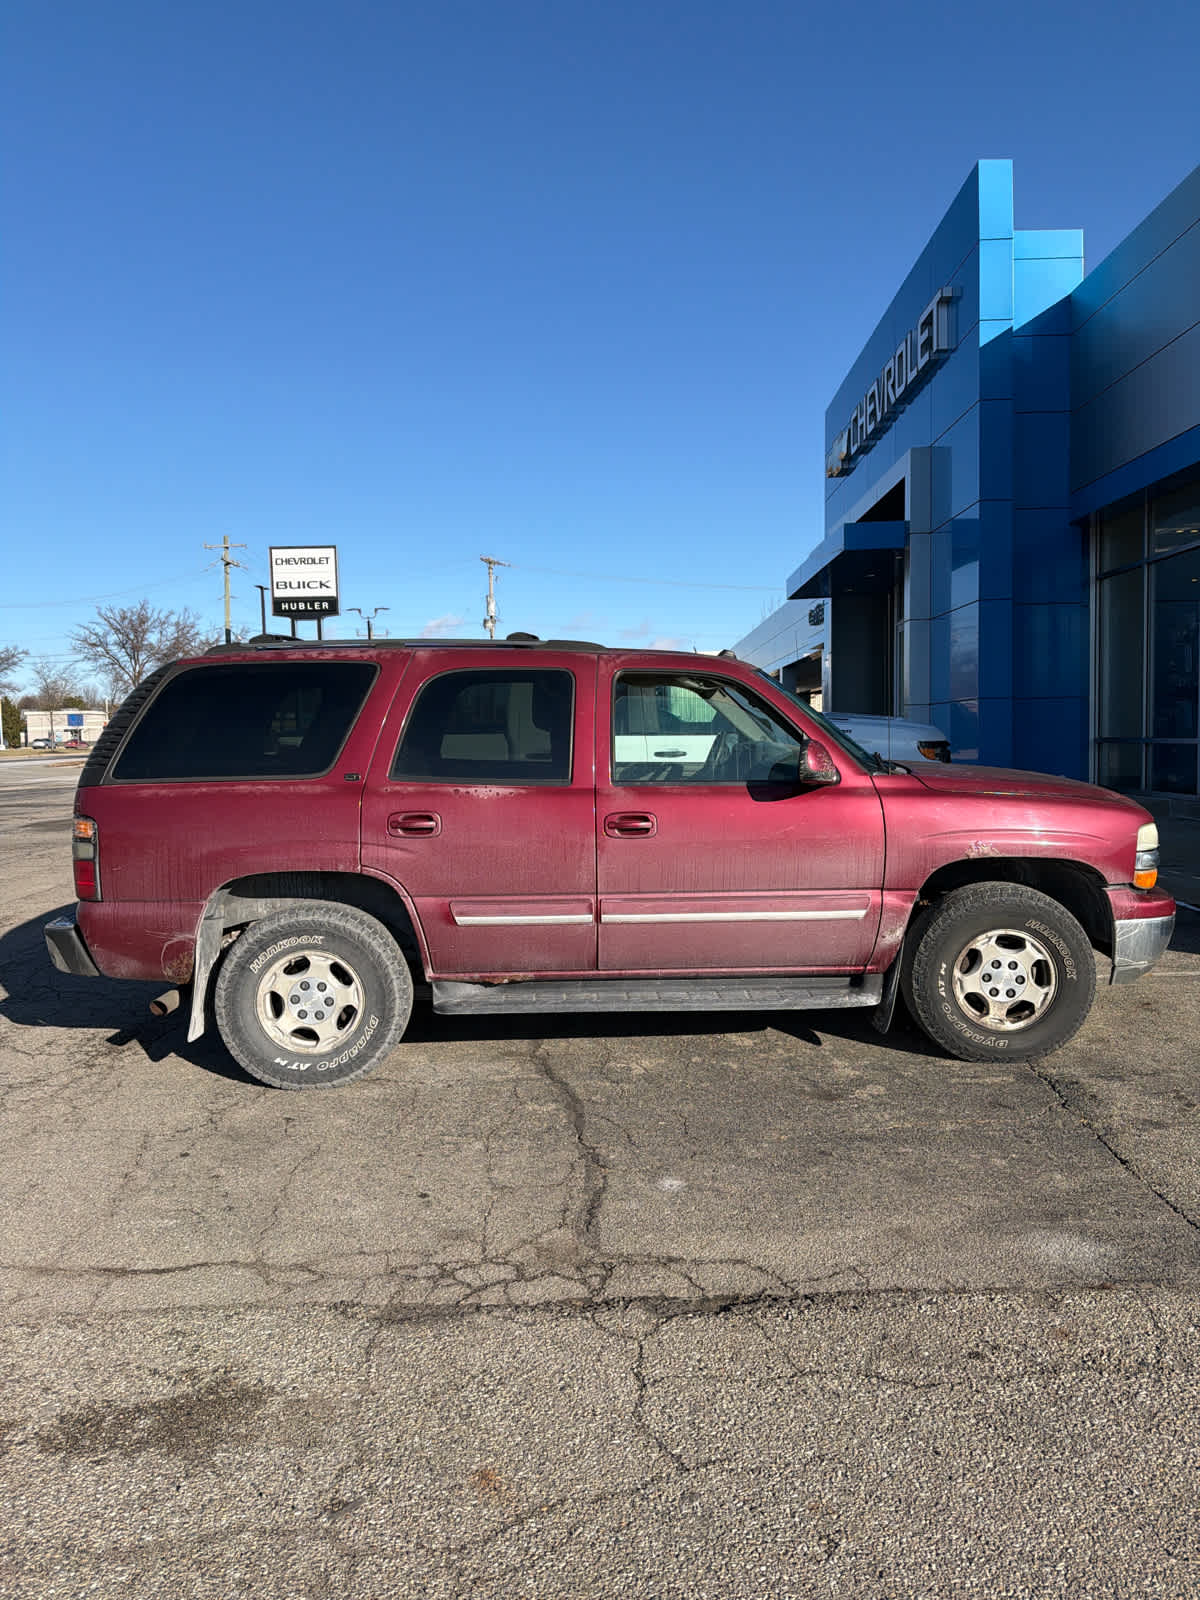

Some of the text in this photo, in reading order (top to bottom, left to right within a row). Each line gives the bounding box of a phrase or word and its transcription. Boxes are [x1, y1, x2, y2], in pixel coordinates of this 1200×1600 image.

[850, 286, 959, 456] CHEVROLET
[275, 556, 330, 566] CHEVROLET
[275, 580, 333, 590] BUICK
[281, 601, 329, 611] HUBLER
